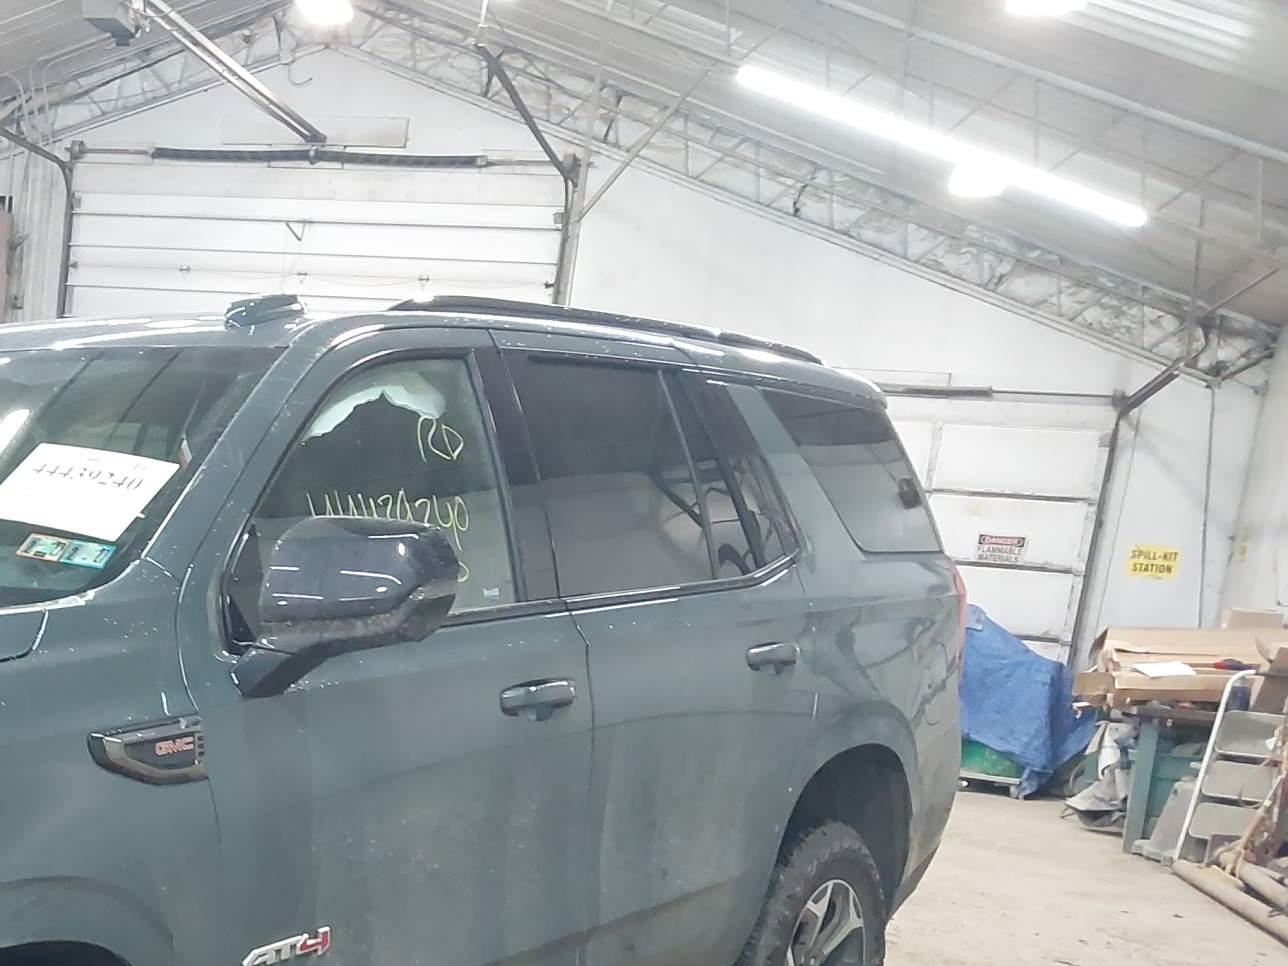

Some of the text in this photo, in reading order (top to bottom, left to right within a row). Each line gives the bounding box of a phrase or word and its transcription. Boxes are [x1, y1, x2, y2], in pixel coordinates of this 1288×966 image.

[1131, 550, 1178, 561] SPILL-KIT
[1132, 562, 1173, 574] STATION
[155, 737, 194, 756] GMC
